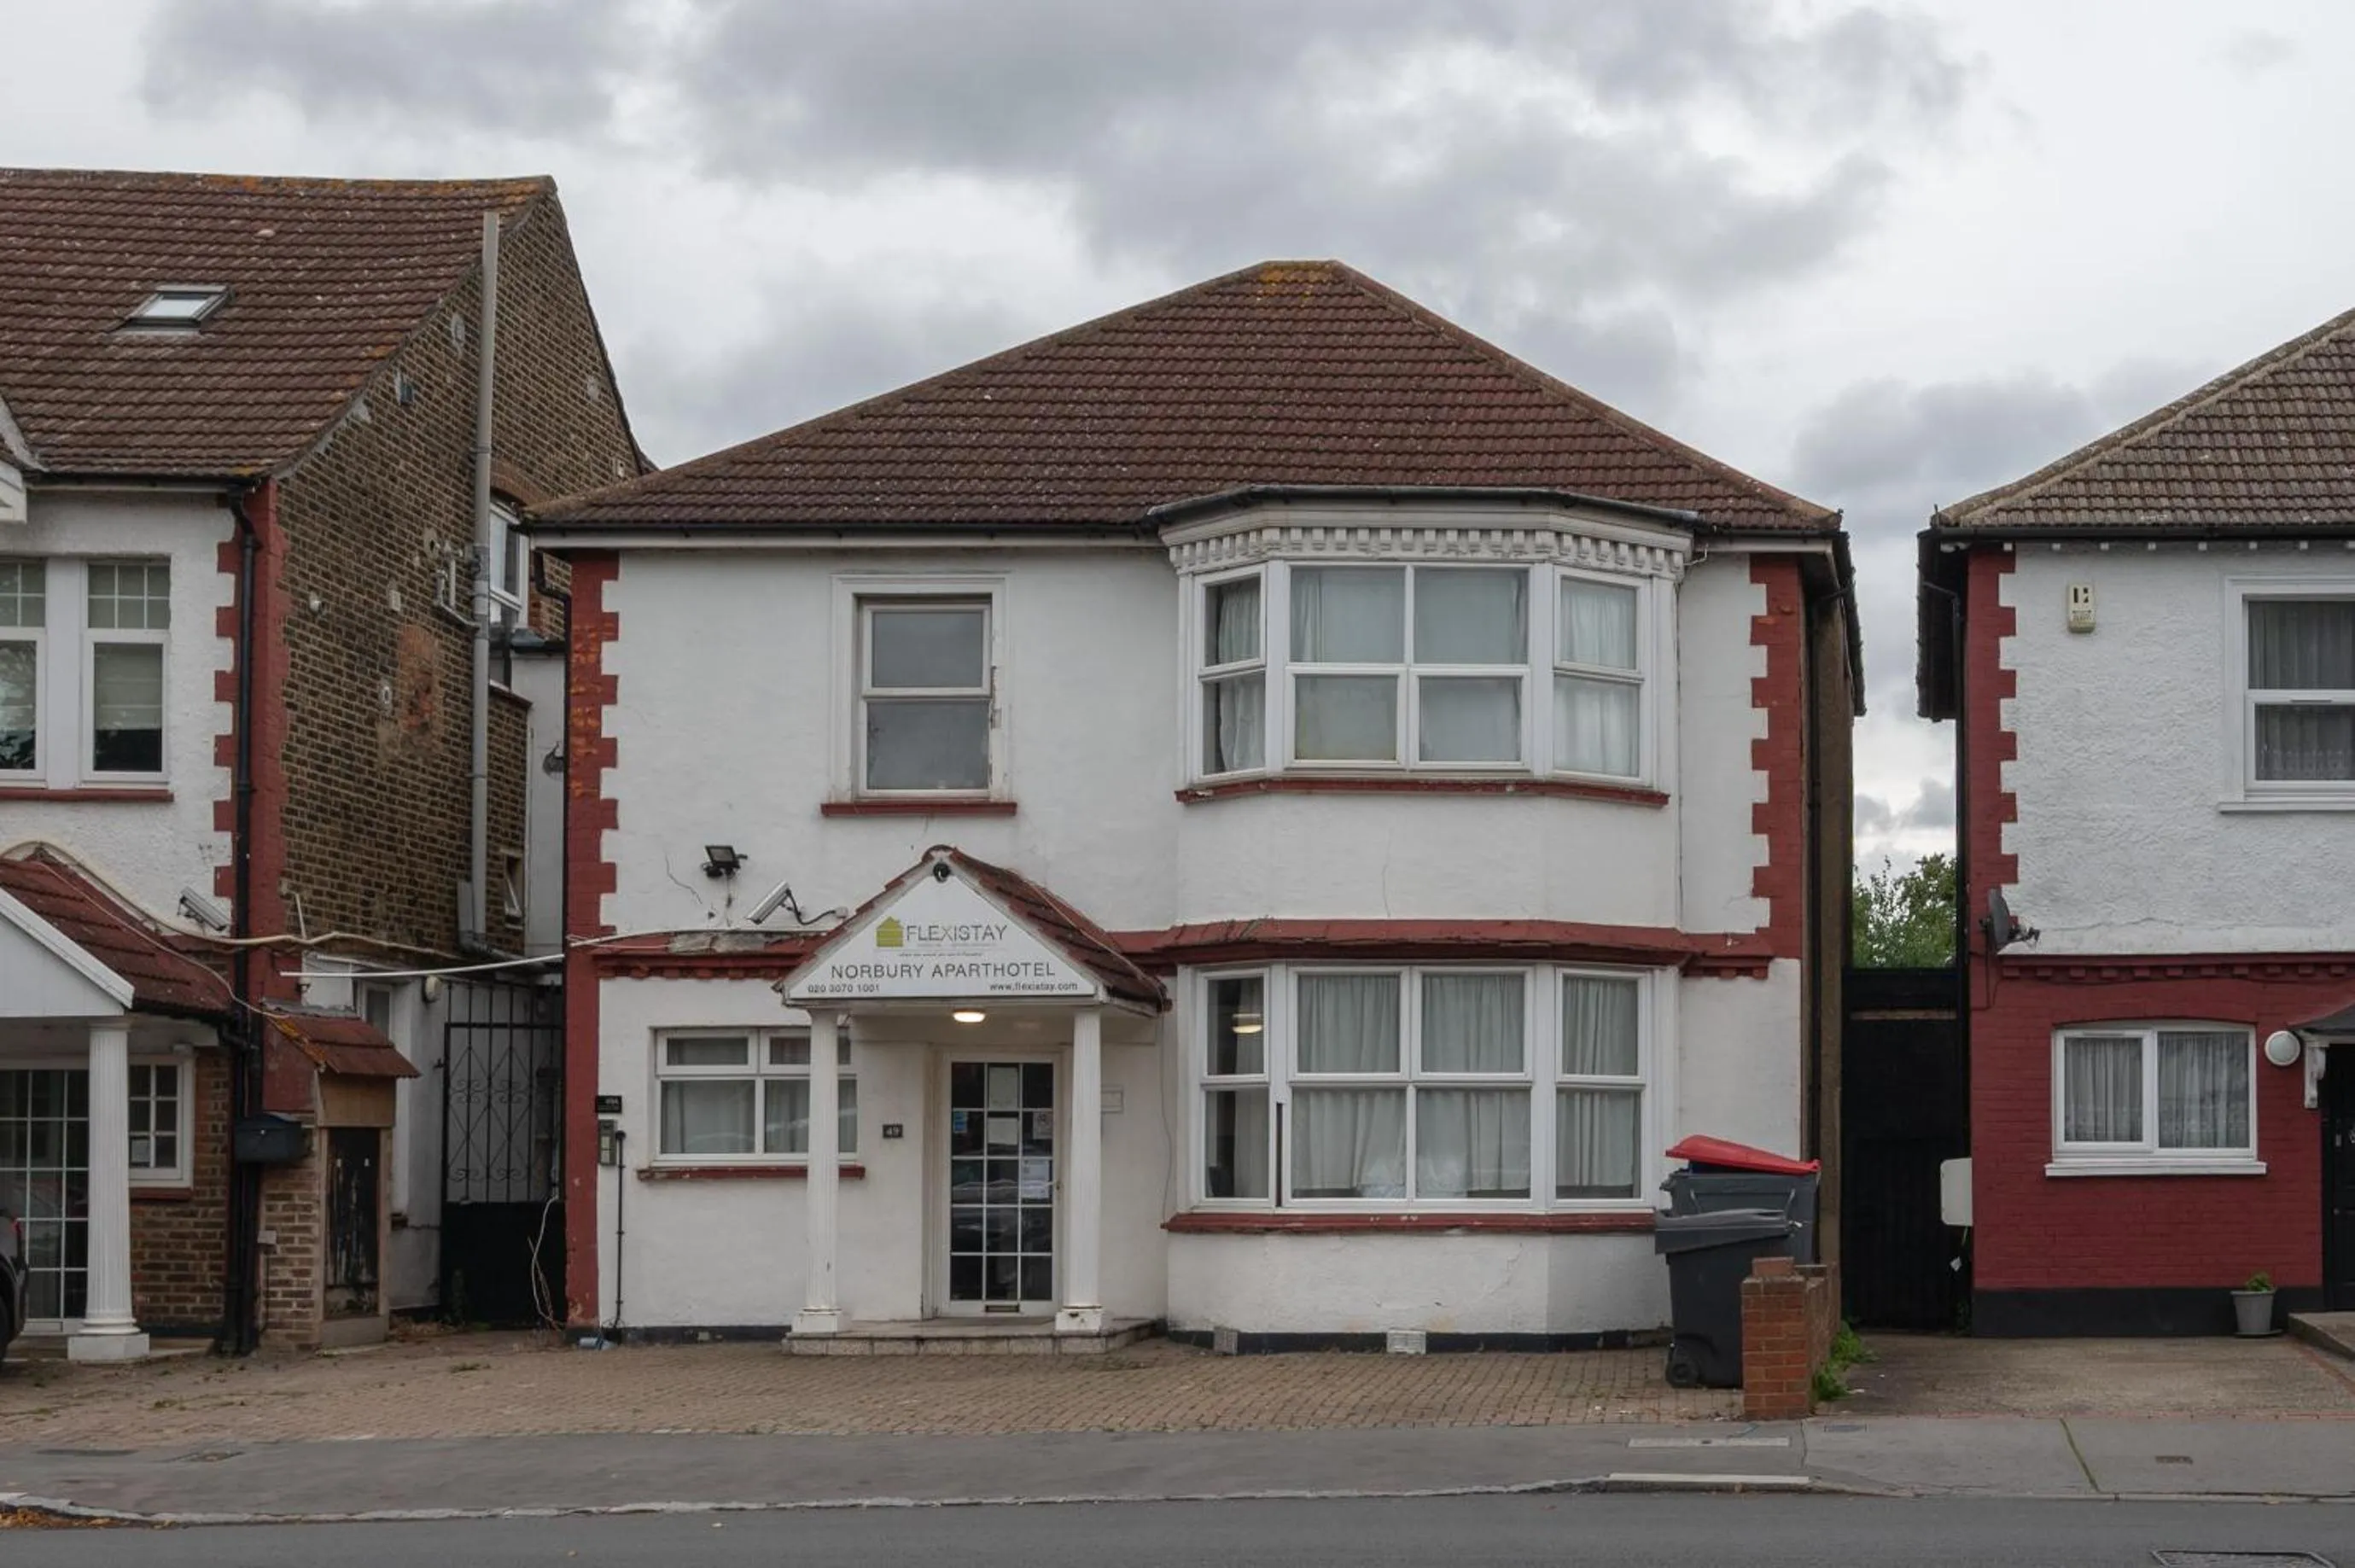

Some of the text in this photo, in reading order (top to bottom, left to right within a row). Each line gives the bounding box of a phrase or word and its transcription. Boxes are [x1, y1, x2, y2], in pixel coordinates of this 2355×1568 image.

[906, 924, 1008, 941] FLEXISTAY
[831, 962, 1056, 979] NORBURY APARTHOTEL
[807, 983, 826, 993] 020
[989, 981, 1078, 992] www.flexistay.com
